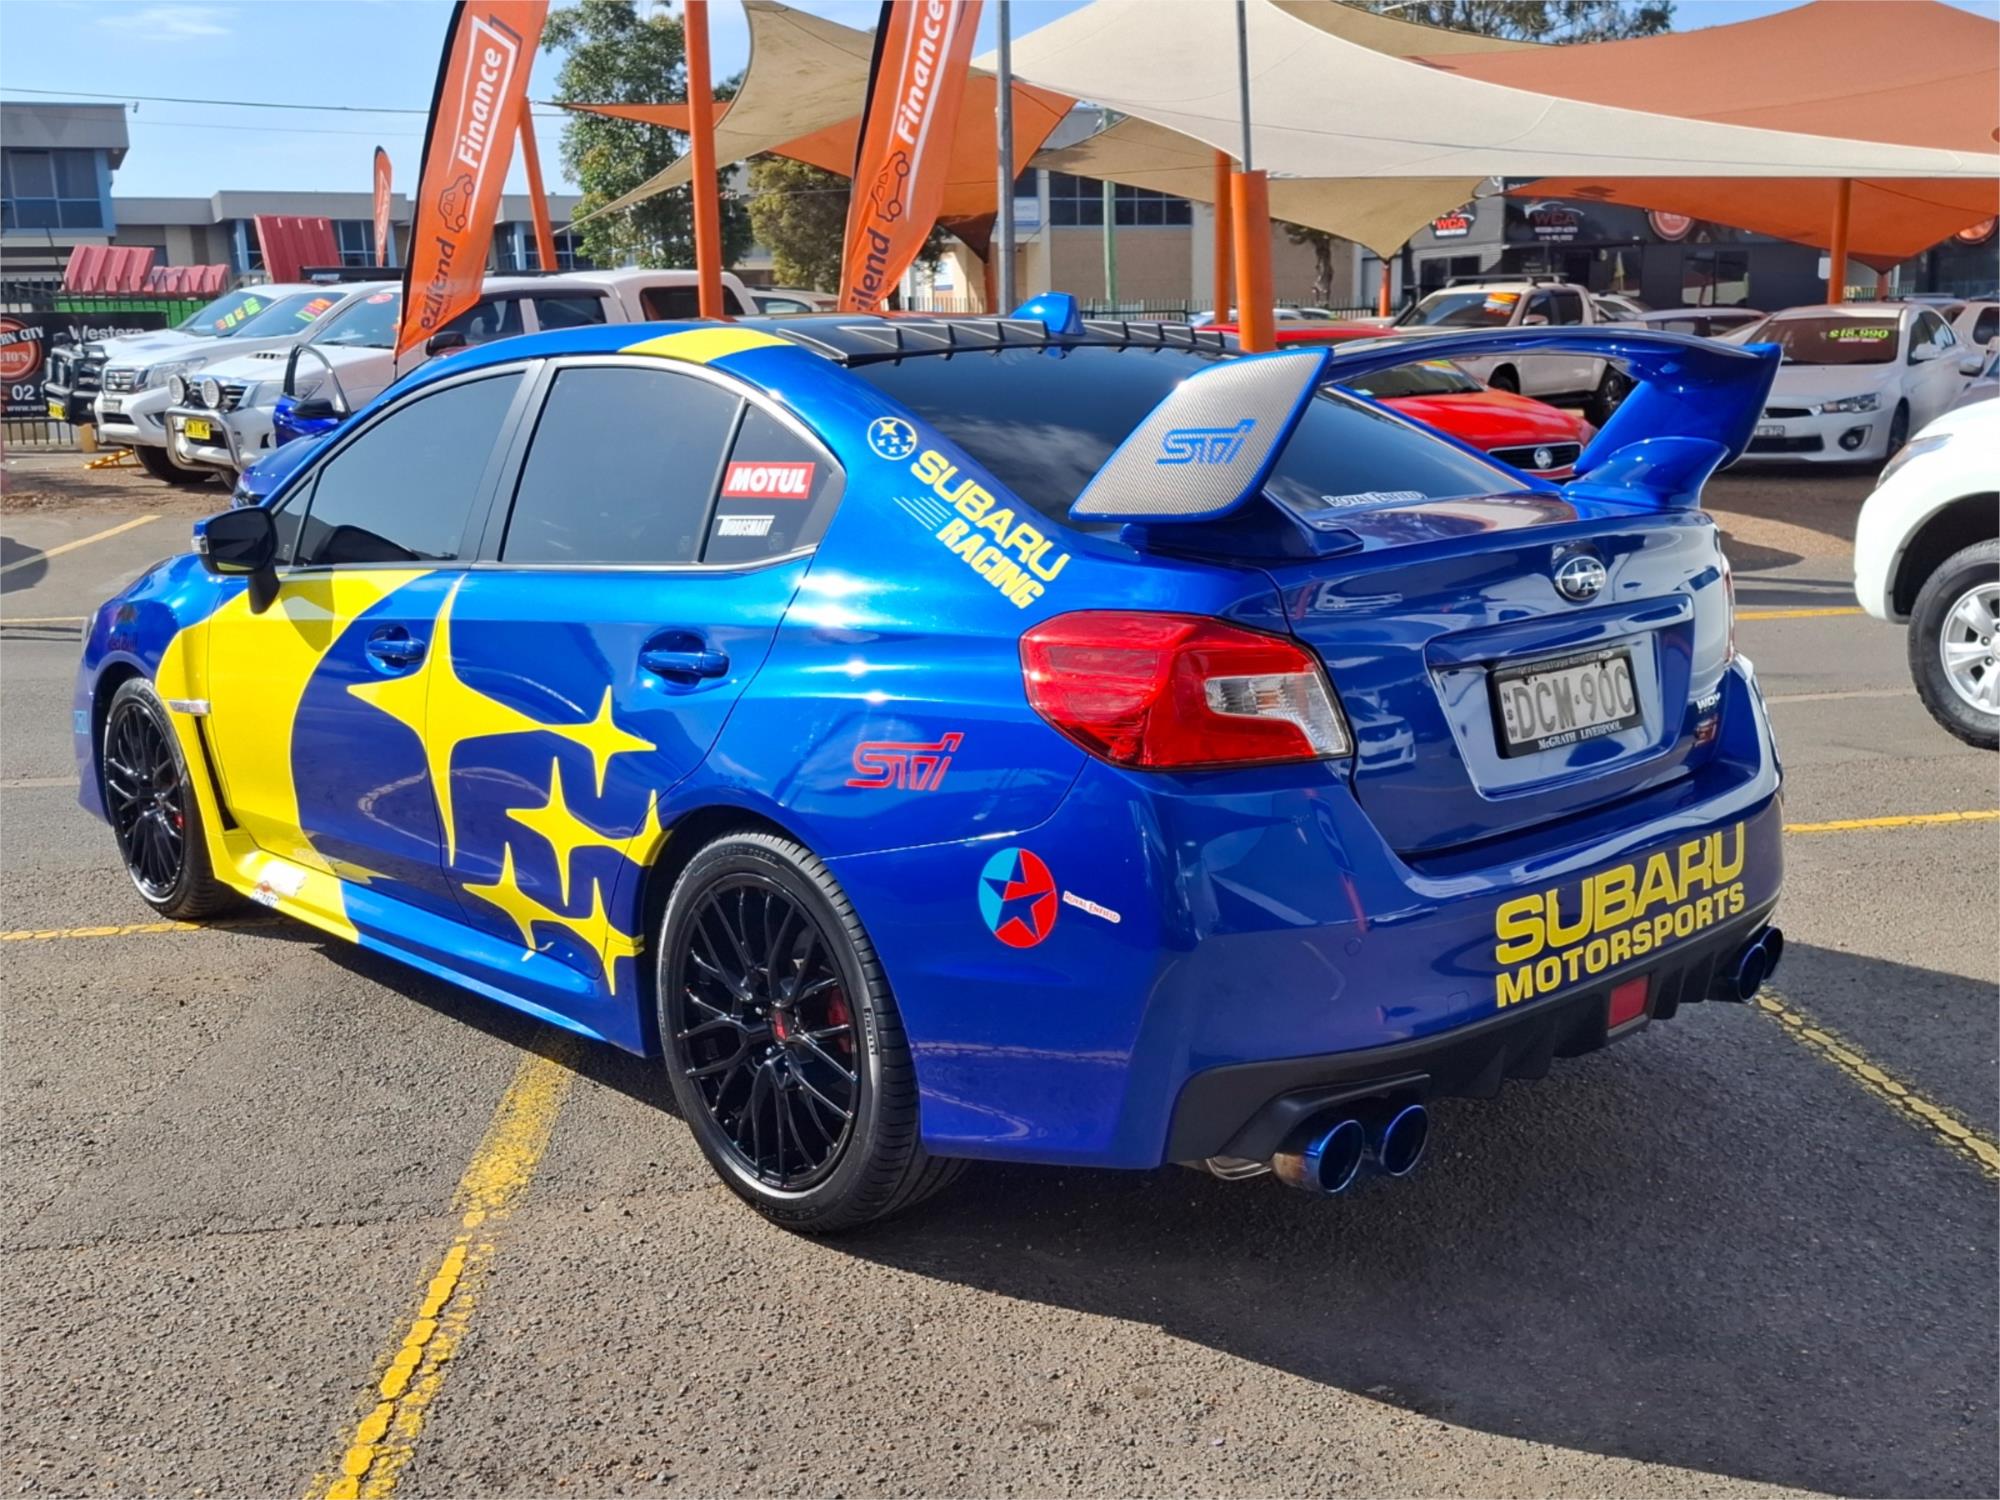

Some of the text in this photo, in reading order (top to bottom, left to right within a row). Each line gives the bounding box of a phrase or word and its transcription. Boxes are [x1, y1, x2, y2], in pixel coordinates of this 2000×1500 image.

[458, 48, 502, 169] Finance
[897, 0, 944, 144] Finance
[19, 326, 44, 341] CITY
[12, 384, 36, 401] 02
[728, 467, 807, 494] MOTUL
[911, 450, 1071, 582] SUBARU
[936, 517, 1046, 609] RACING
[1580, 720, 1623, 741] LIVERPOOL
[1495, 821, 1745, 965] SUBARU
[1496, 881, 1745, 1008] MOTORSPORTS
